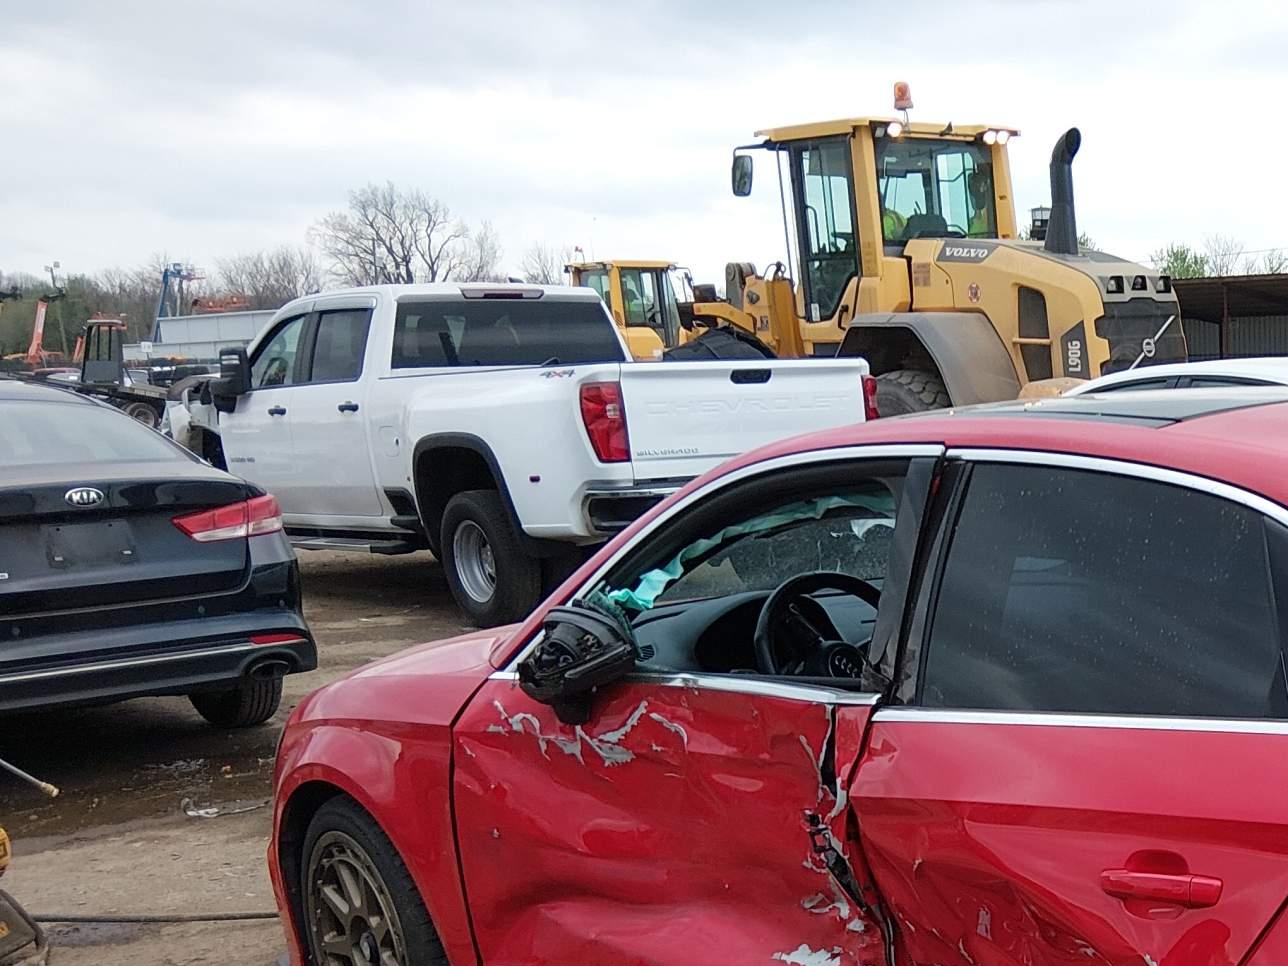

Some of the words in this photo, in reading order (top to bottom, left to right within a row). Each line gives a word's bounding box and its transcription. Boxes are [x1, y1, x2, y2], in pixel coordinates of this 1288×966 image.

[945, 246, 988, 258] VOLVO
[1068, 340, 1081, 372] L90G
[70, 490, 102, 504] KIA
